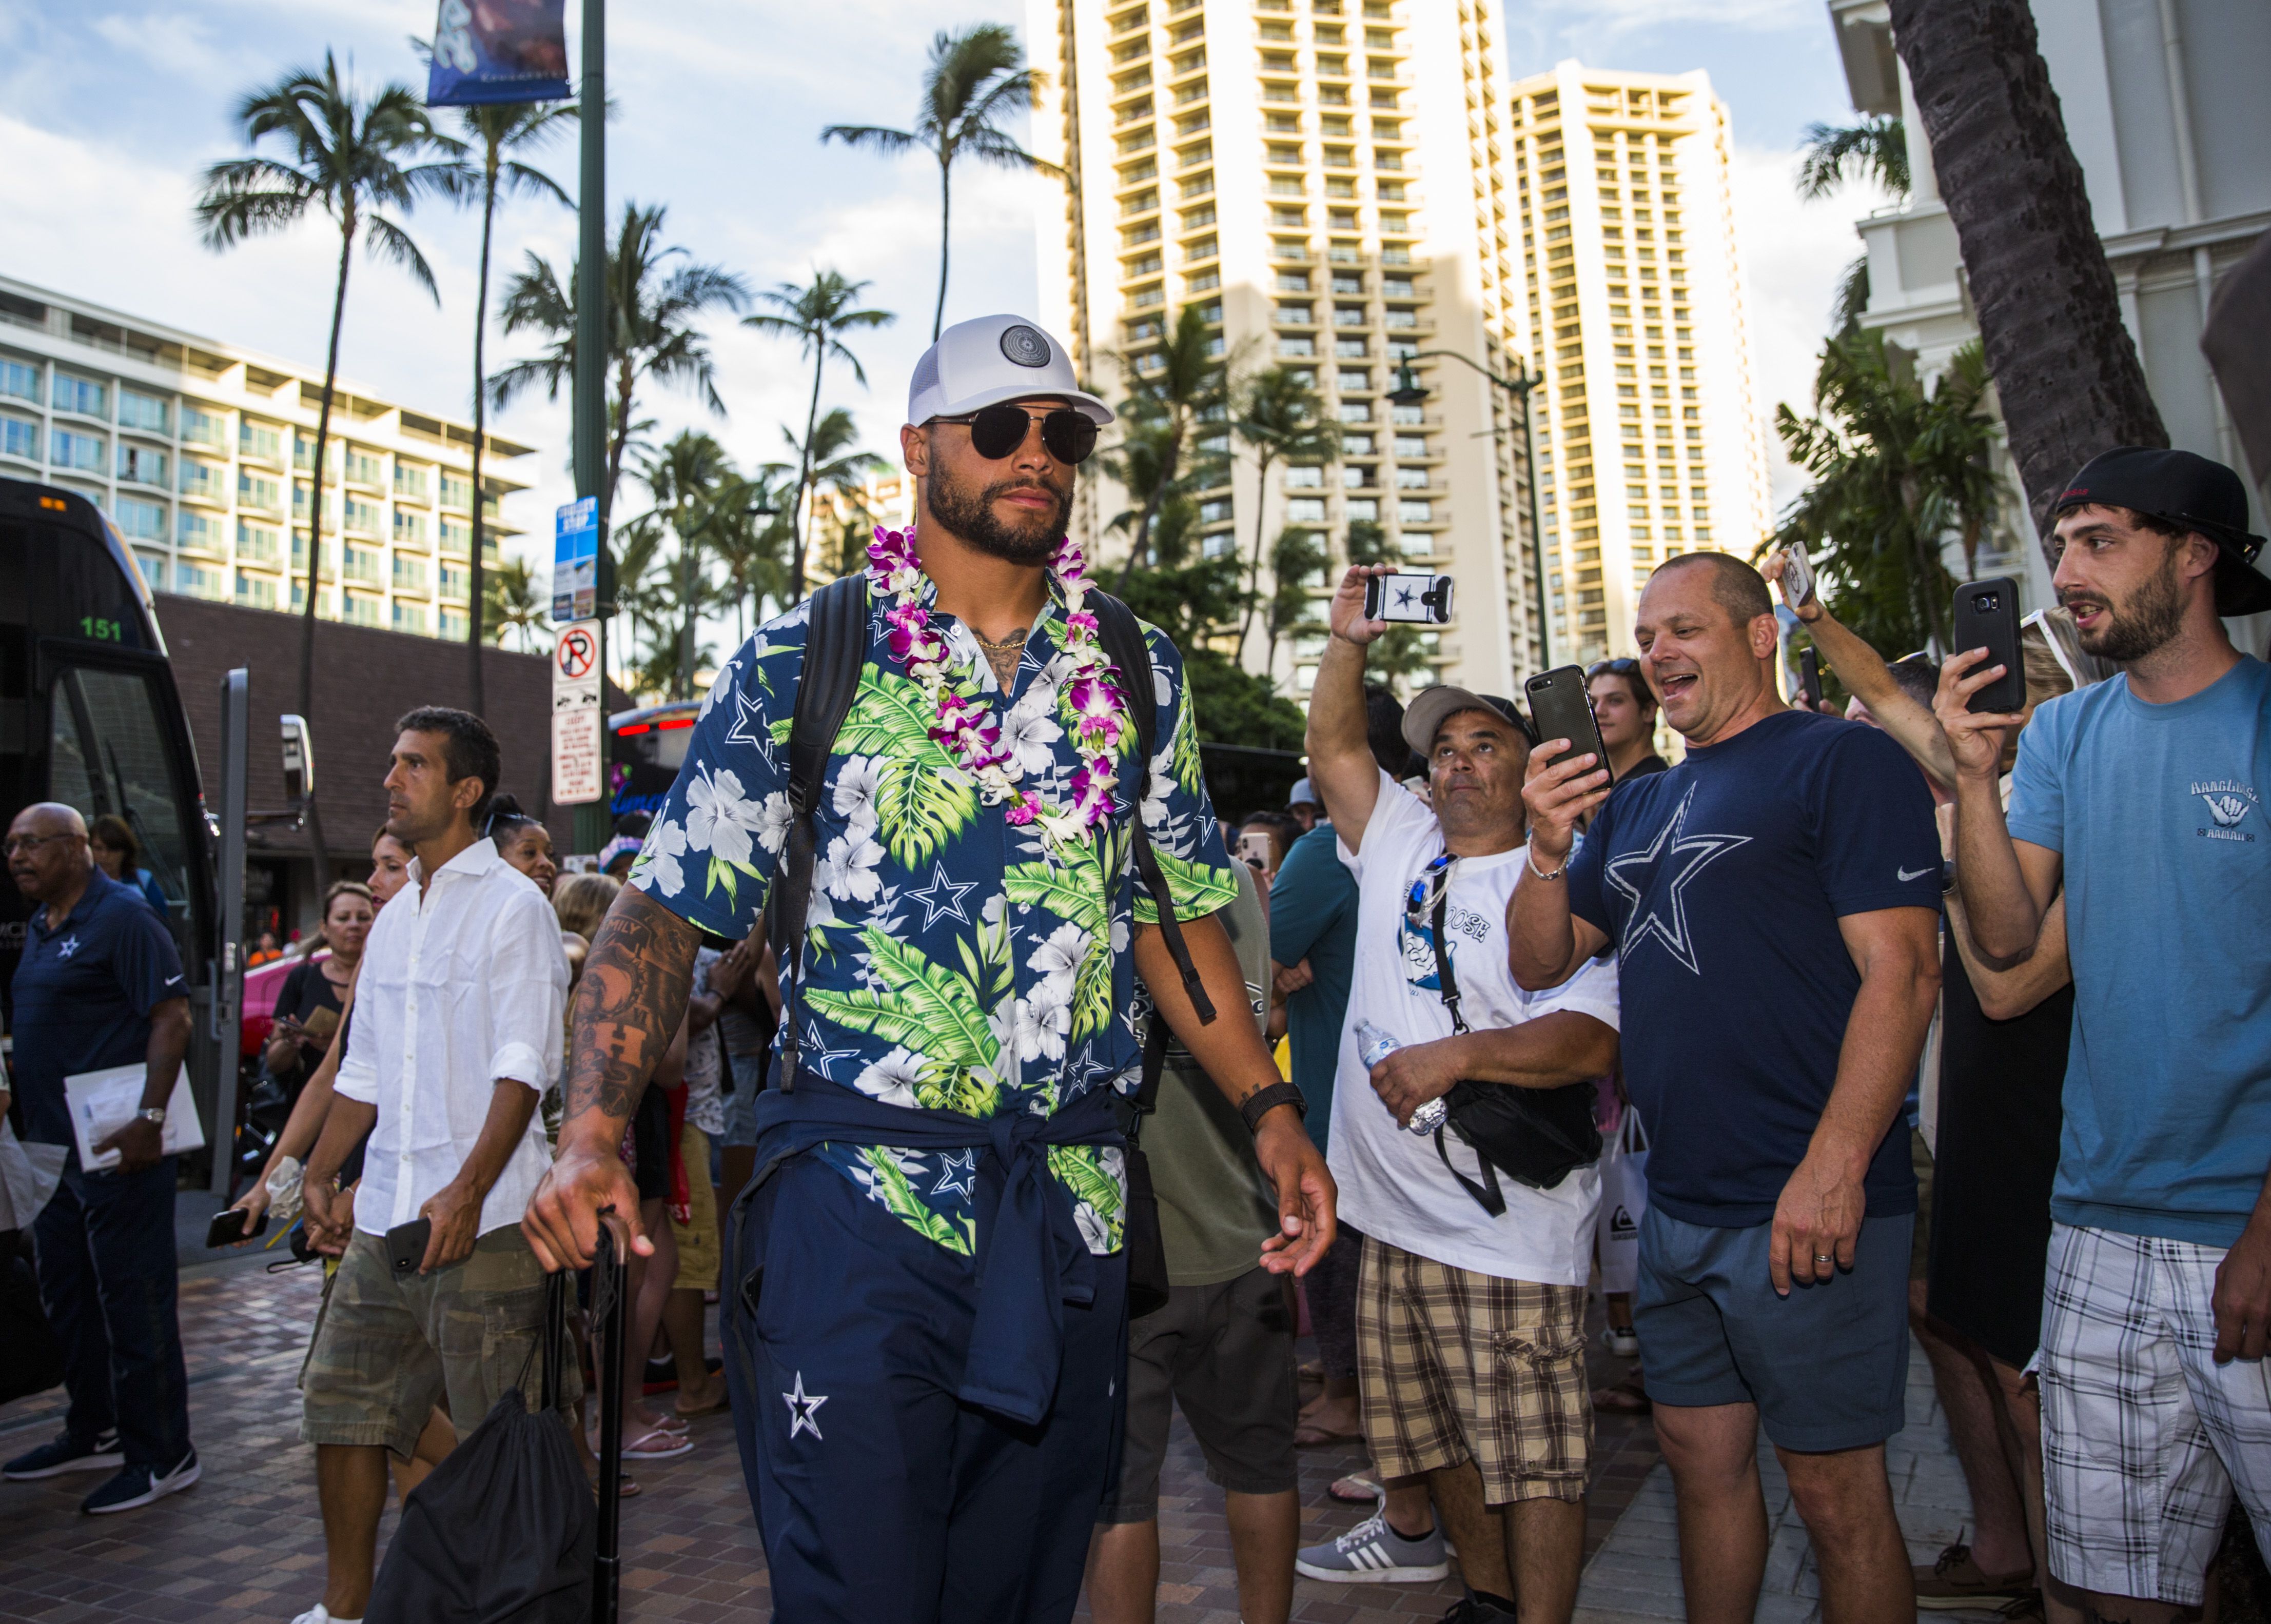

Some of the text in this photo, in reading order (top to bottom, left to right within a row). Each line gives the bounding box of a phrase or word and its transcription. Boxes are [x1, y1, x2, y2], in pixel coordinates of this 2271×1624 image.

[81, 616, 122, 642] 151
[2206, 829, 2245, 841] HAWAII
[1430, 906, 1491, 943] OOSE
